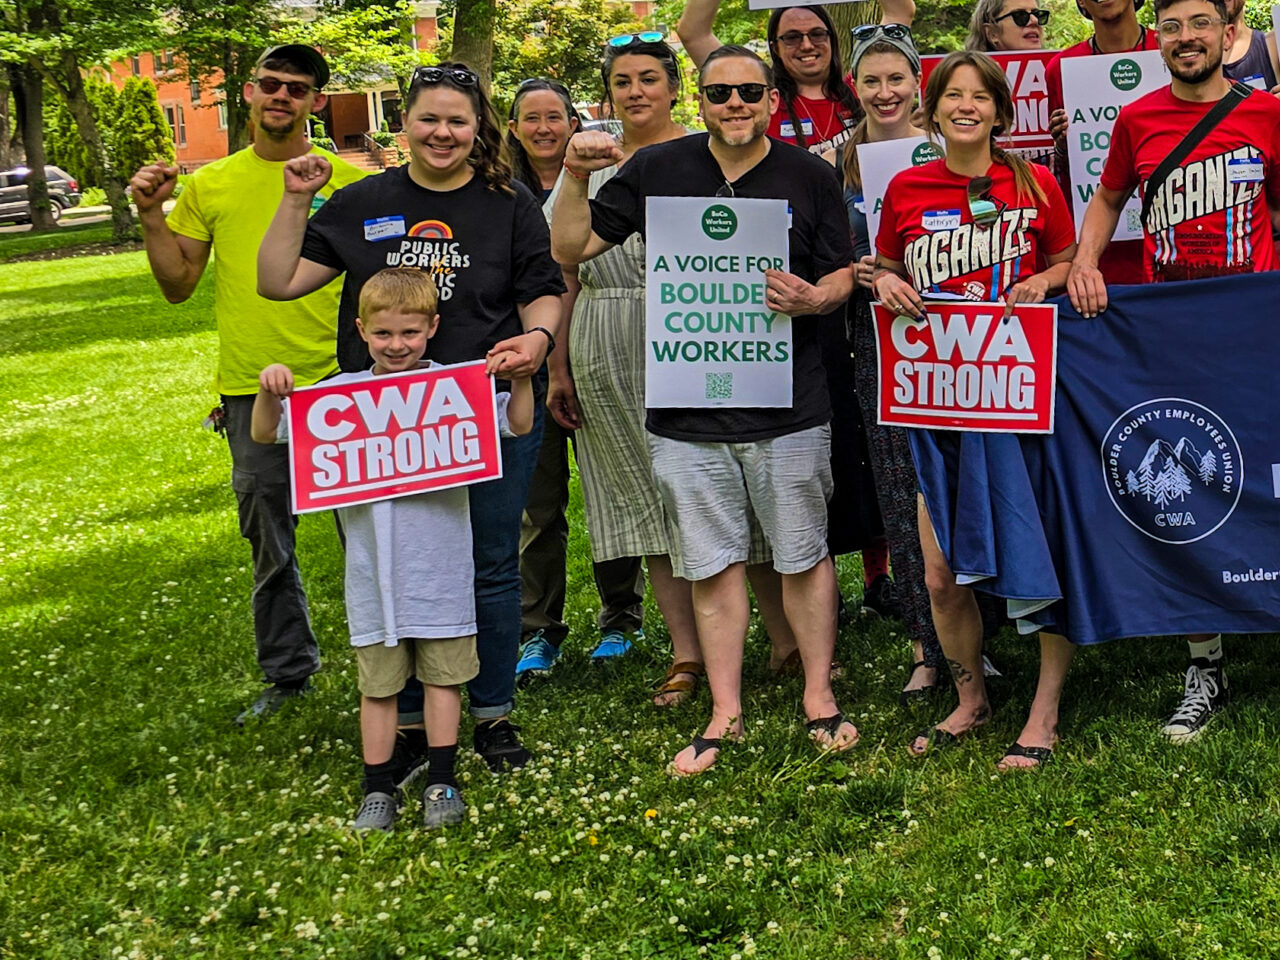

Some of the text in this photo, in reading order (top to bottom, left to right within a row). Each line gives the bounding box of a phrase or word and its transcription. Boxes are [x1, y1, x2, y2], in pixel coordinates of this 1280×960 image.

[1072, 108, 1086, 124] A
[400, 240, 460, 255] PUBLIC
[386, 252, 471, 268] WORKERS
[653, 255, 785, 273] A VOICE FOR
[660, 282, 767, 305] BOULDE
[664, 311, 778, 334] COUNTY
[890, 312, 1036, 364] CWA
[652, 341, 789, 363] WORKERS
[893, 359, 1036, 411] STRONG
[306, 376, 476, 441] CWA
[311, 420, 481, 488] STRONG
[1109, 409, 1234, 496] BOULDER COUNTY EMPLOYEES UNION
[1154, 511, 1196, 527] CWA
